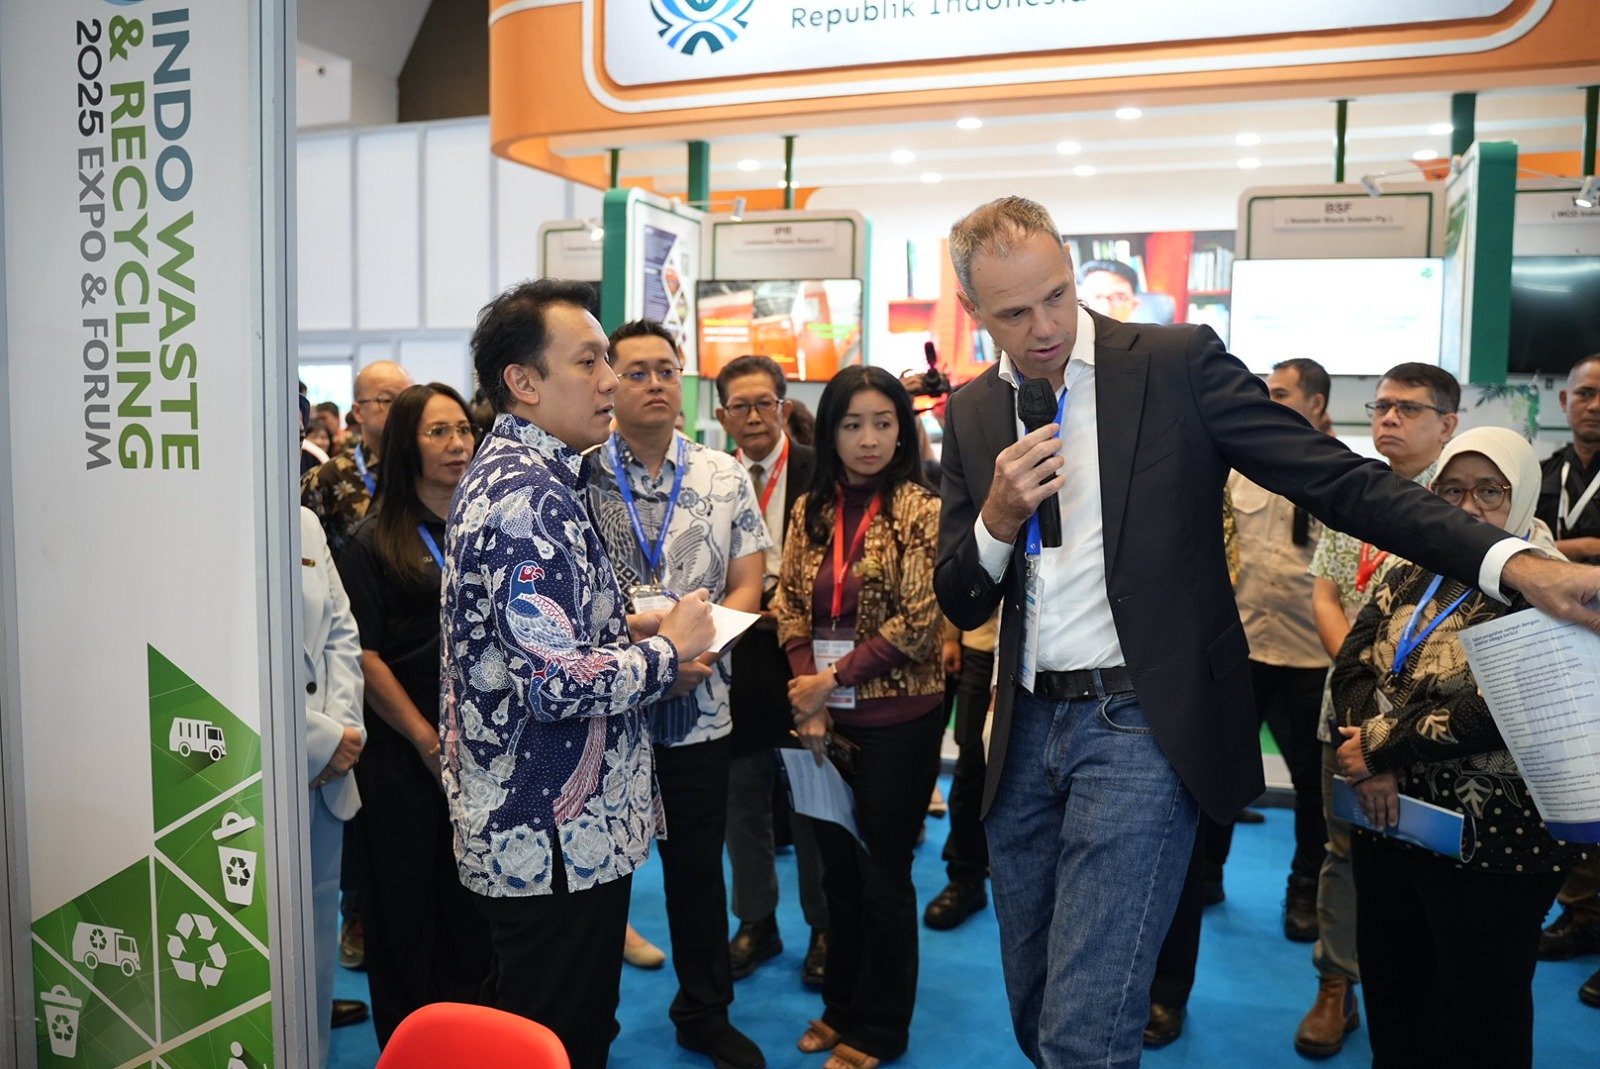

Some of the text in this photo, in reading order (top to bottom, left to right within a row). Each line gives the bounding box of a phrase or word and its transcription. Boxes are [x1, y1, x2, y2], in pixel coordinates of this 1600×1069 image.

[108, 15, 153, 470] & RECYCLING
[152, 8, 200, 470] INDO WASTE
[791, 1, 916, 32] Republik
[1325, 202, 1352, 214] BSF
[76, 18, 112, 471] 2025 EXPO & FORUM
